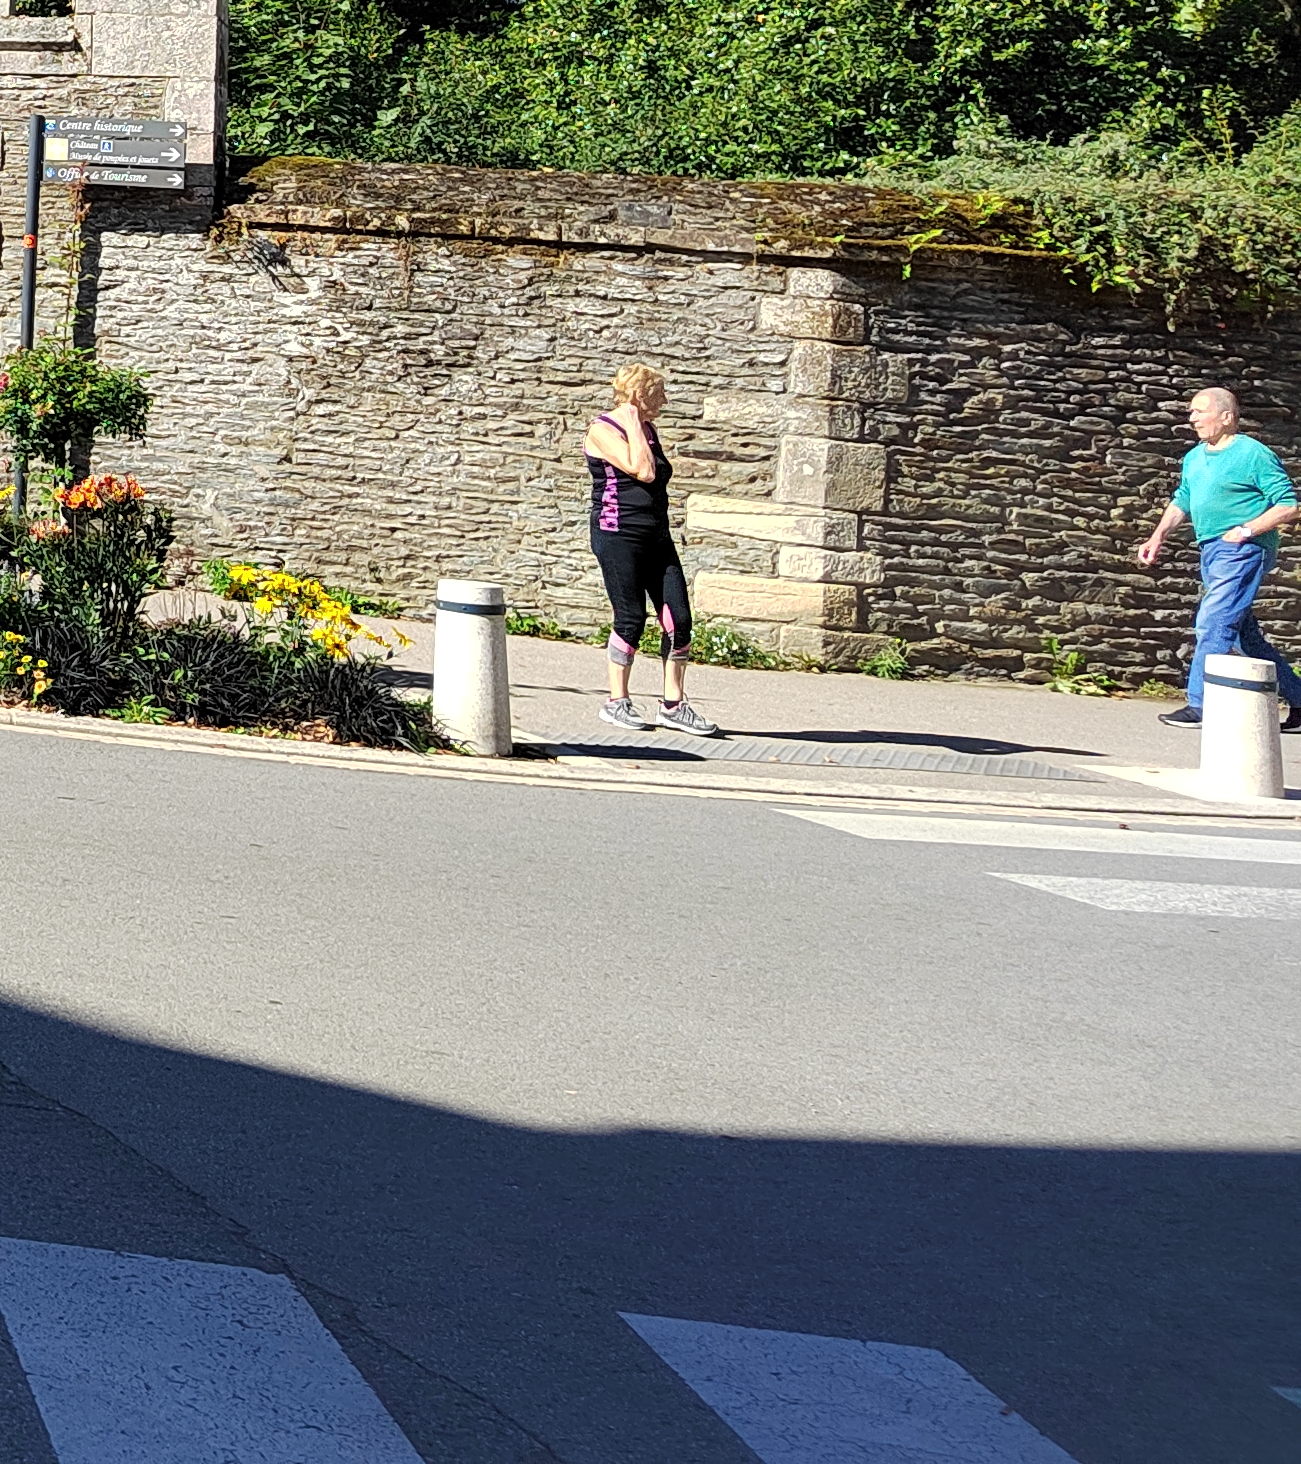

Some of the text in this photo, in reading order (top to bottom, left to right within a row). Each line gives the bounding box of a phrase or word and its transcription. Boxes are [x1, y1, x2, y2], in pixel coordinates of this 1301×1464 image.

[59, 119, 144, 135] Centre historique
[69, 139, 98, 149] Château
[93, 153, 102, 161] de
[137, 155, 159, 165] jouets
[58, 167, 148, 183] Offie de Tourisme
